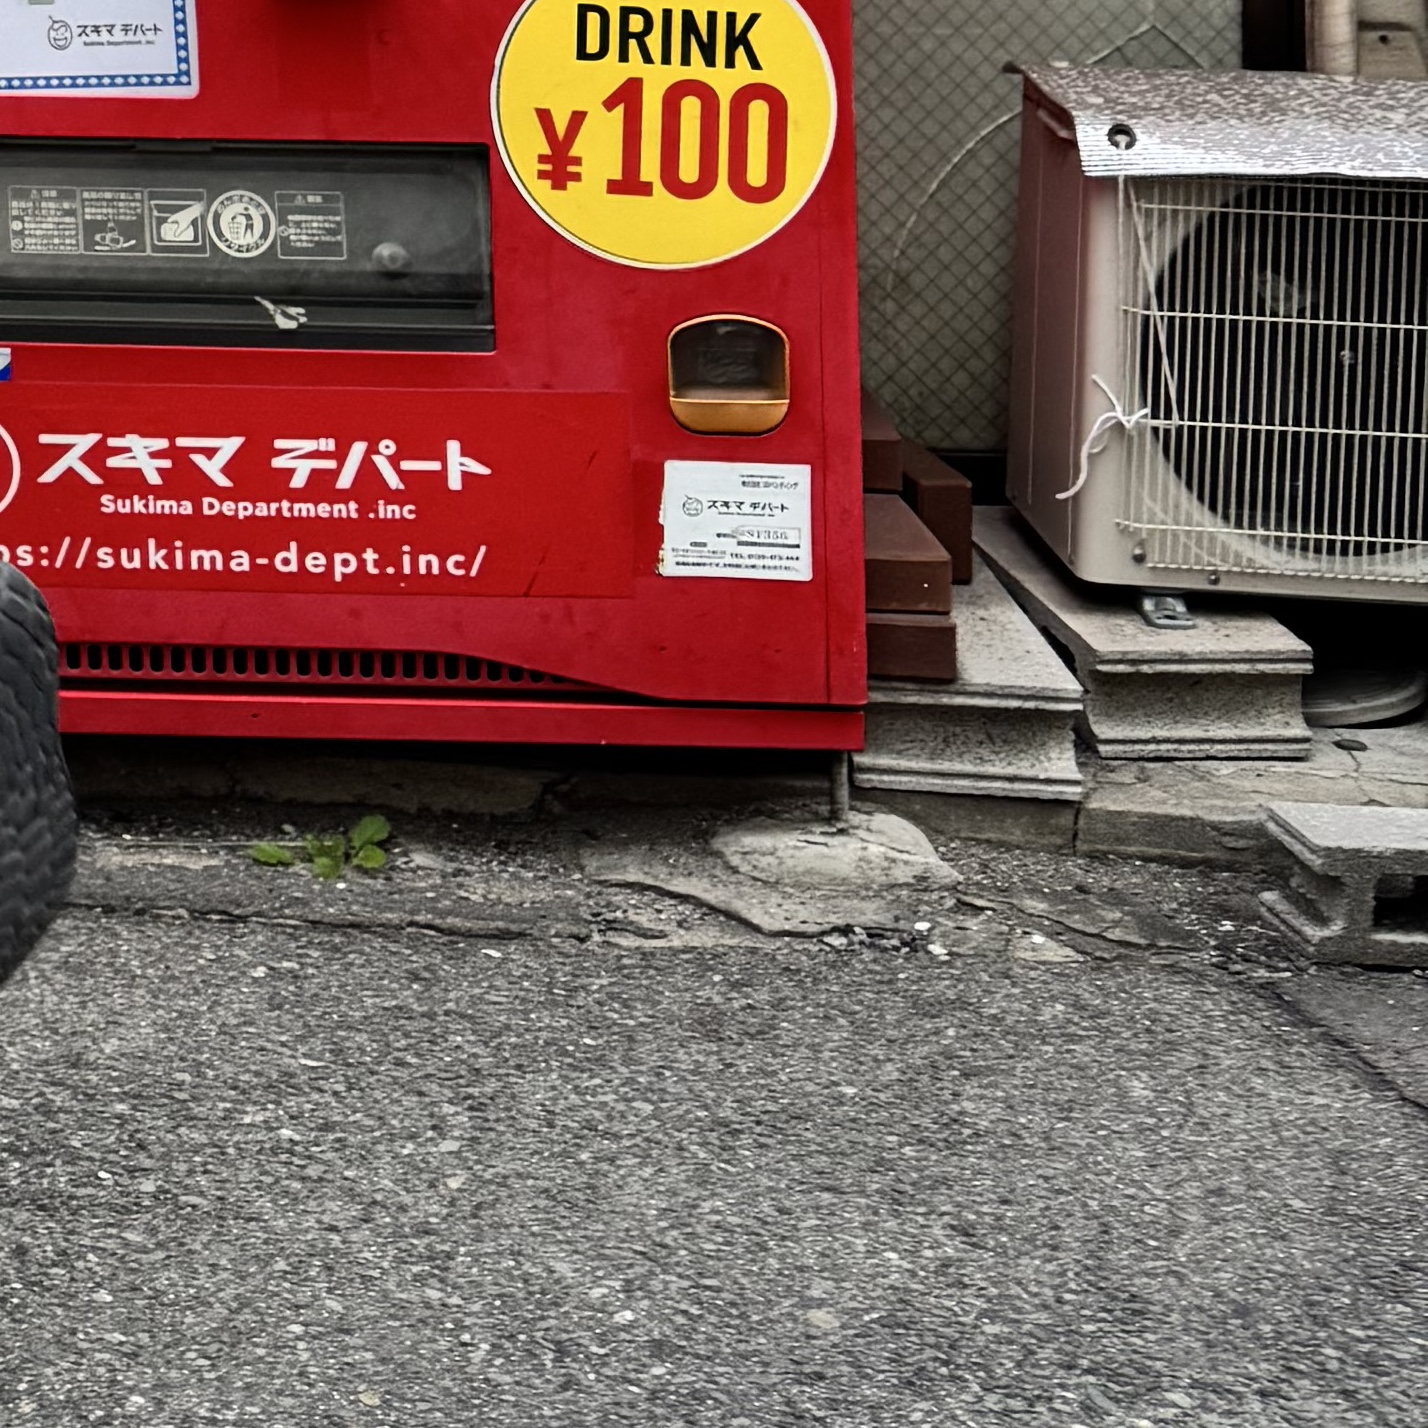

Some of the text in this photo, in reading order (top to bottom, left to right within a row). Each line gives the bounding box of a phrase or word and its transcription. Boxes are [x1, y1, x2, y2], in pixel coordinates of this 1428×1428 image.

[77, 23, 163, 38] スキマ デパート
[575, 3, 764, 71] DRINK
[534, 76, 789, 204] ¥100
[37, 432, 493, 491] スキマ デパート
[99, 493, 418, 521] Sukima Department .inc
[707, 499, 790, 513] スキマ デパート
